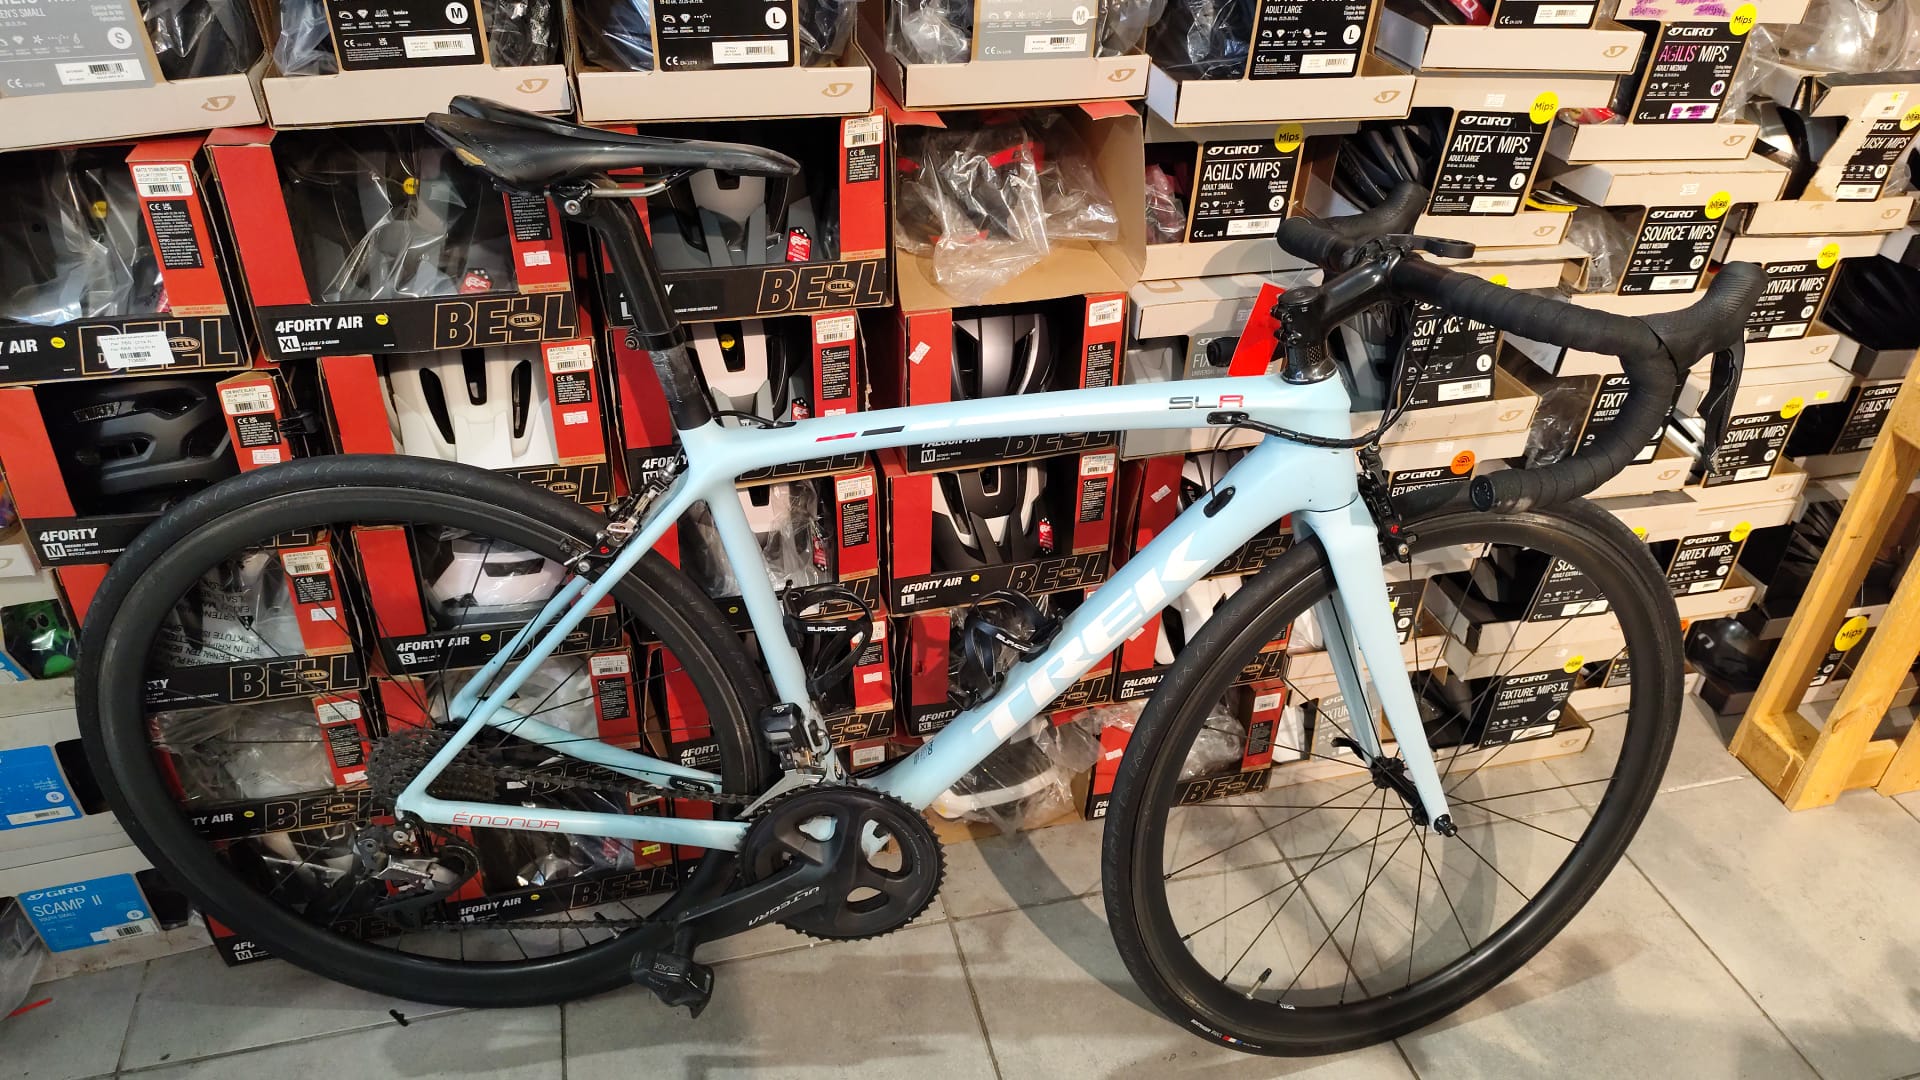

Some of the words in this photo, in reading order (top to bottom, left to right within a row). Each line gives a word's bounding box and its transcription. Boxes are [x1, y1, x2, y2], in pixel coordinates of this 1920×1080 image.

[20, 8, 47, 18] SMALL
[450, 8, 463, 19] M
[1076, 10, 1086, 19] M
[1265, 5, 1283, 14] ADULT
[1283, 5, 1303, 14] LARGE
[772, 12, 781, 24] L
[1733, 15, 1753, 25] Mips
[114, 31, 125, 44] S
[1348, 29, 1355, 40] L
[1682, 27, 1716, 37] GIRO
[1658, 45, 1698, 62] AGILIS
[1698, 45, 1729, 63] MIPS
[1534, 102, 1555, 113] Mips
[1477, 116, 1512, 127] GIRO
[1279, 132, 1300, 142] Mips
[1884, 136, 1911, 149] MIPS
[1224, 145, 1260, 155] GIRO
[1451, 134, 1495, 153] ARTEX
[1496, 136, 1531, 154] MIPS
[1203, 163, 1245, 181] AGILIS
[1248, 161, 1280, 179] MIPS
[1202, 183, 1218, 191] ADULT
[1664, 210, 1696, 219] GIRO
[1641, 226, 1687, 241] SOURCE
[1687, 225, 1718, 240] MIPS
[1779, 264, 1808, 274] GIRO
[757, 261, 885, 314] BELL
[830, 282, 851, 290] BELL
[1762, 278, 1799, 294] YNTAX
[1798, 277, 1826, 292] MIPS
[275, 317, 333, 334] 4FORTY
[336, 316, 363, 330] AIR
[434, 293, 576, 350] BELL
[514, 314, 538, 324] BELL
[9, 338, 39, 354] AIR
[168, 339, 196, 350] BELL
[280, 337, 300, 351] XL
[1169, 394, 1244, 410] SLR
[1743, 415, 1771, 425] GIRO
[1724, 427, 1762, 444] SYNTAX
[1761, 424, 1788, 439] MIPS
[923, 450, 934, 462] M
[1410, 469, 1442, 480] GIRO
[40, 527, 98, 543] 4FORTY
[46, 545, 62, 556] M
[1676, 548, 1709, 561] ARTEX
[1708, 544, 1733, 557] MIPS
[1006, 555, 1104, 593] BELL
[901, 580, 943, 595] 4FORTY
[943, 577, 963, 587] AIR
[971, 530, 1209, 741] TREK
[1840, 626, 1863, 641] Mips
[396, 639, 445, 652] 4FORTY
[448, 636, 470, 647] AIR
[403, 654, 413, 664] S
[230, 654, 360, 703] BELL
[303, 672, 325, 680] BELL
[1123, 676, 1158, 689] FALCON
[1520, 674, 1549, 684] GIRO
[1500, 687, 1536, 700] FIXTURE
[1536, 683, 1558, 696] MIPS
[1557, 682, 1570, 692] XL
[918, 709, 958, 722] 4FORTY
[1180, 769, 1264, 805] BELL
[211, 812, 235, 824] AIR
[264, 790, 385, 833] BELL
[452, 811, 560, 831] ÉMONDA
[46, 885, 87, 898] GIRO
[32, 897, 86, 917] SCAMP
[502, 897, 522, 908] AIR
[748, 886, 820, 926] ULTEGRA
[238, 950, 251, 960] M
